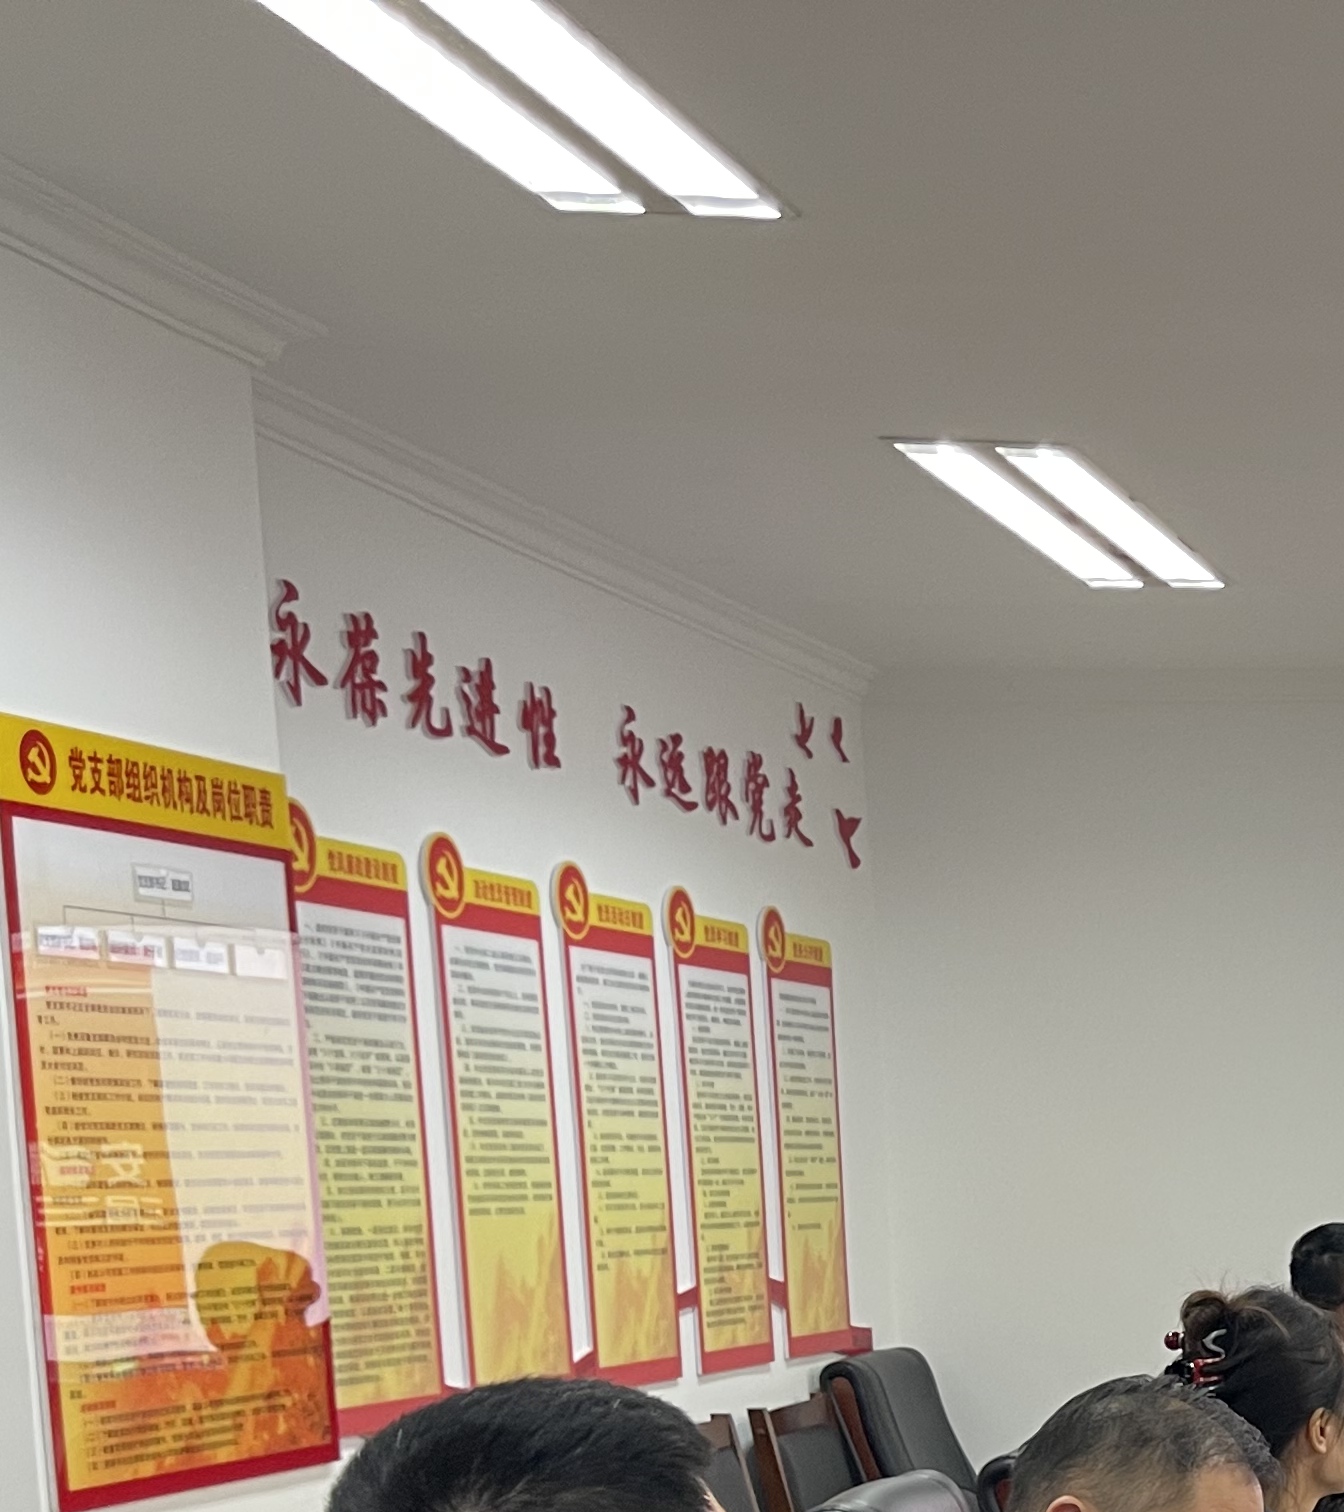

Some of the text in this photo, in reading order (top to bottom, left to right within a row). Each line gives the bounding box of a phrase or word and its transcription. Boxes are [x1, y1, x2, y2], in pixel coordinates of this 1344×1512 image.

[270, 578, 561, 770] 永葆先进性
[68, 747, 275, 830] 党支部组织机构及岗位职责
[616, 704, 814, 847] 永远跟党走
